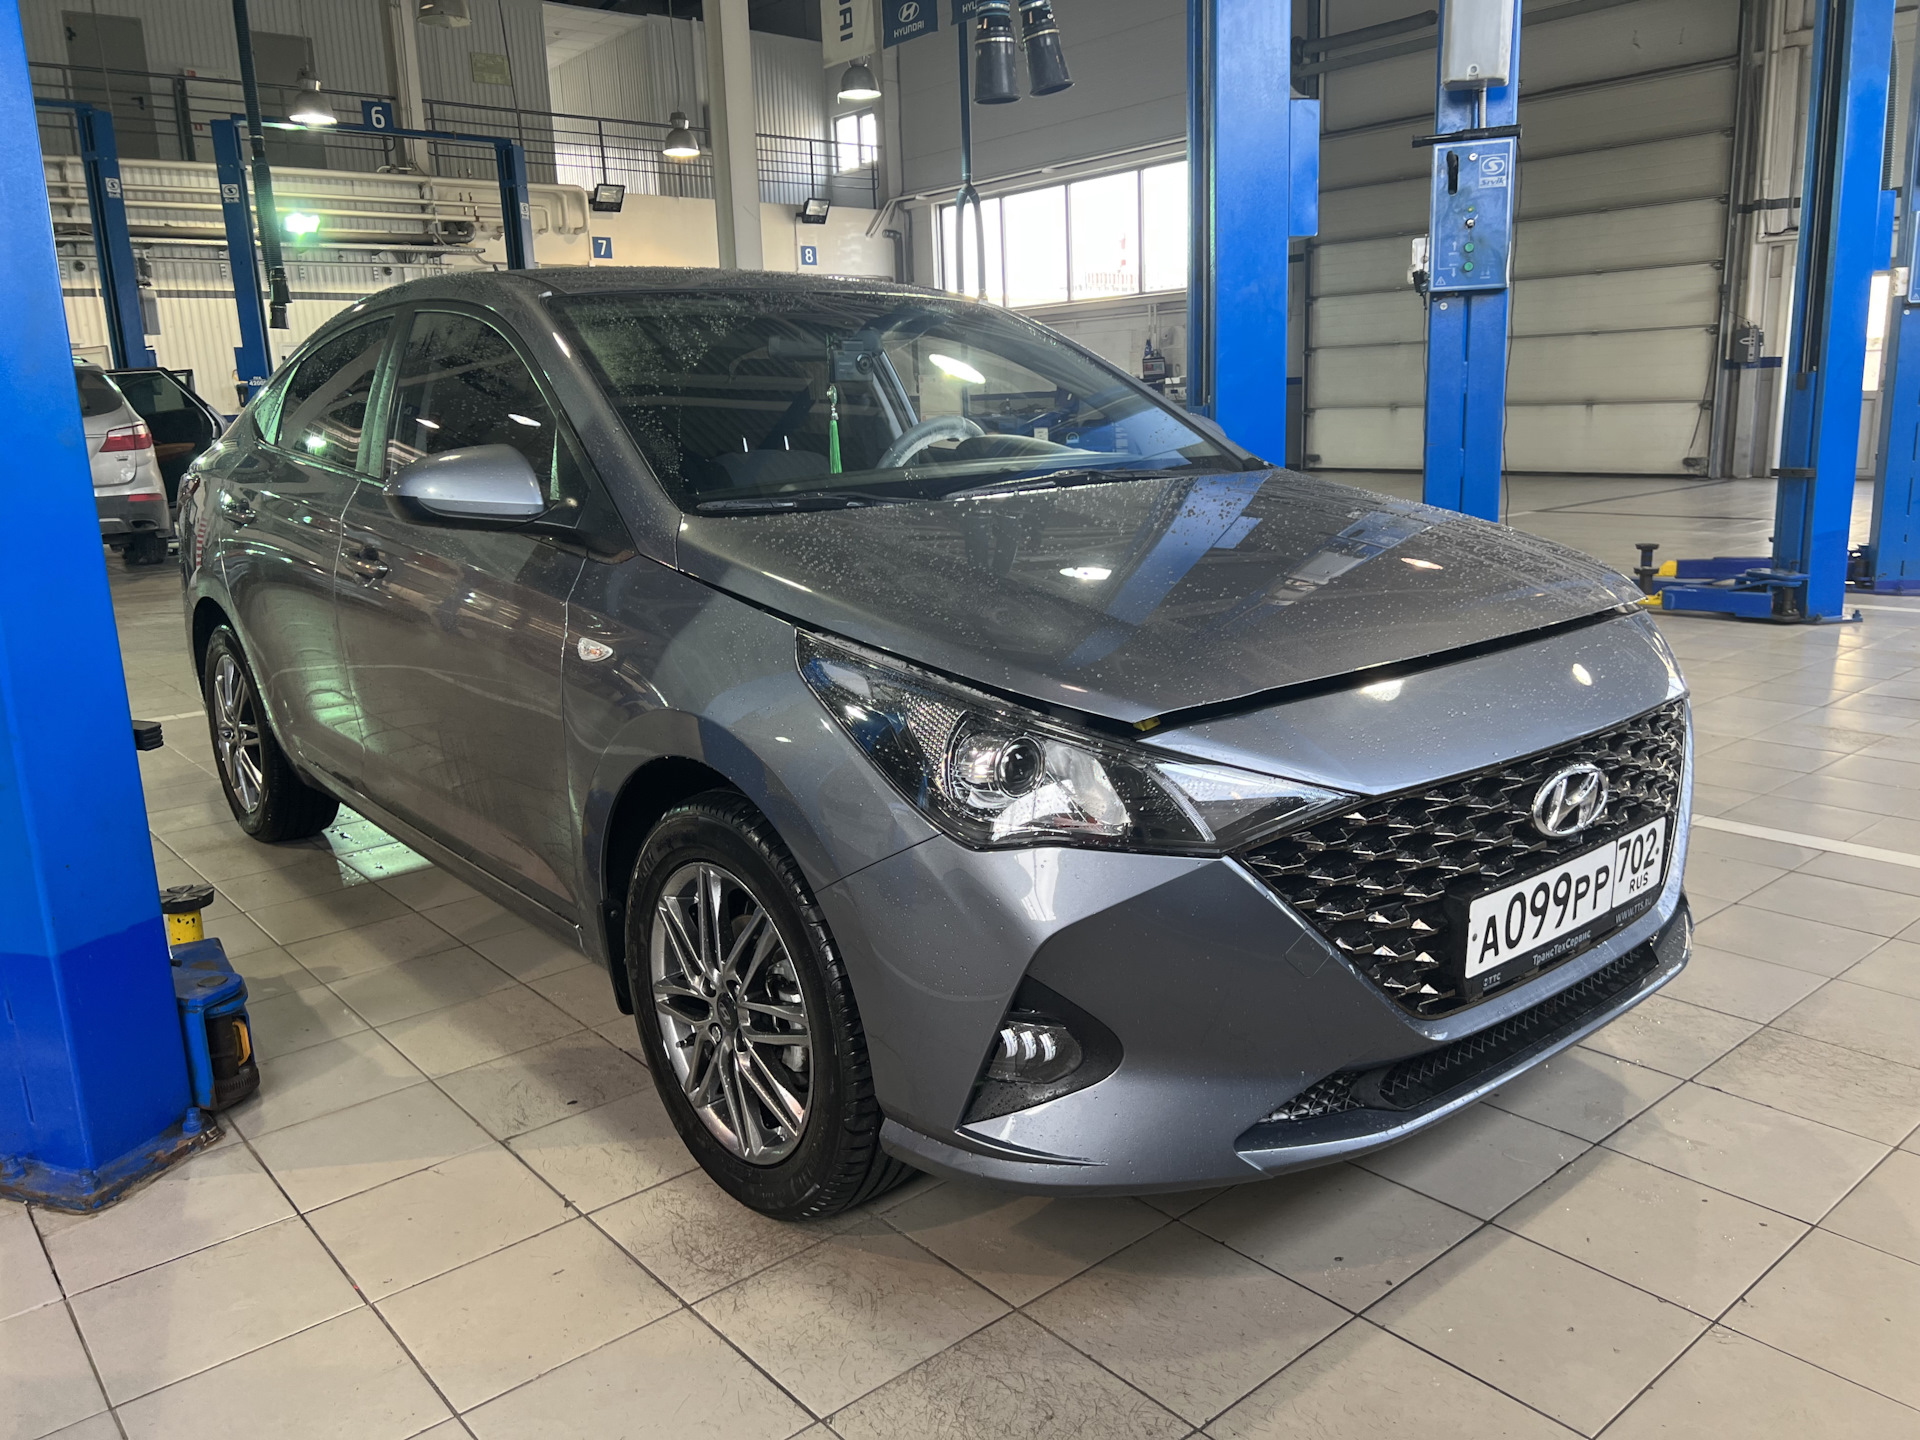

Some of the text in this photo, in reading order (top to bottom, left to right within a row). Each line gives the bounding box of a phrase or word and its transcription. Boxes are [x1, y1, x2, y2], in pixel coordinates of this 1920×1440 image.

[893, 20, 925, 39] HYUNDAI
[371, 106, 386, 128] 6
[597, 239, 607, 256] 7
[805, 248, 813, 263] 8
[1618, 827, 1658, 883] 702
[1628, 872, 1649, 894] RUS
[1532, 930, 1592, 966] ТрансТехСервис
